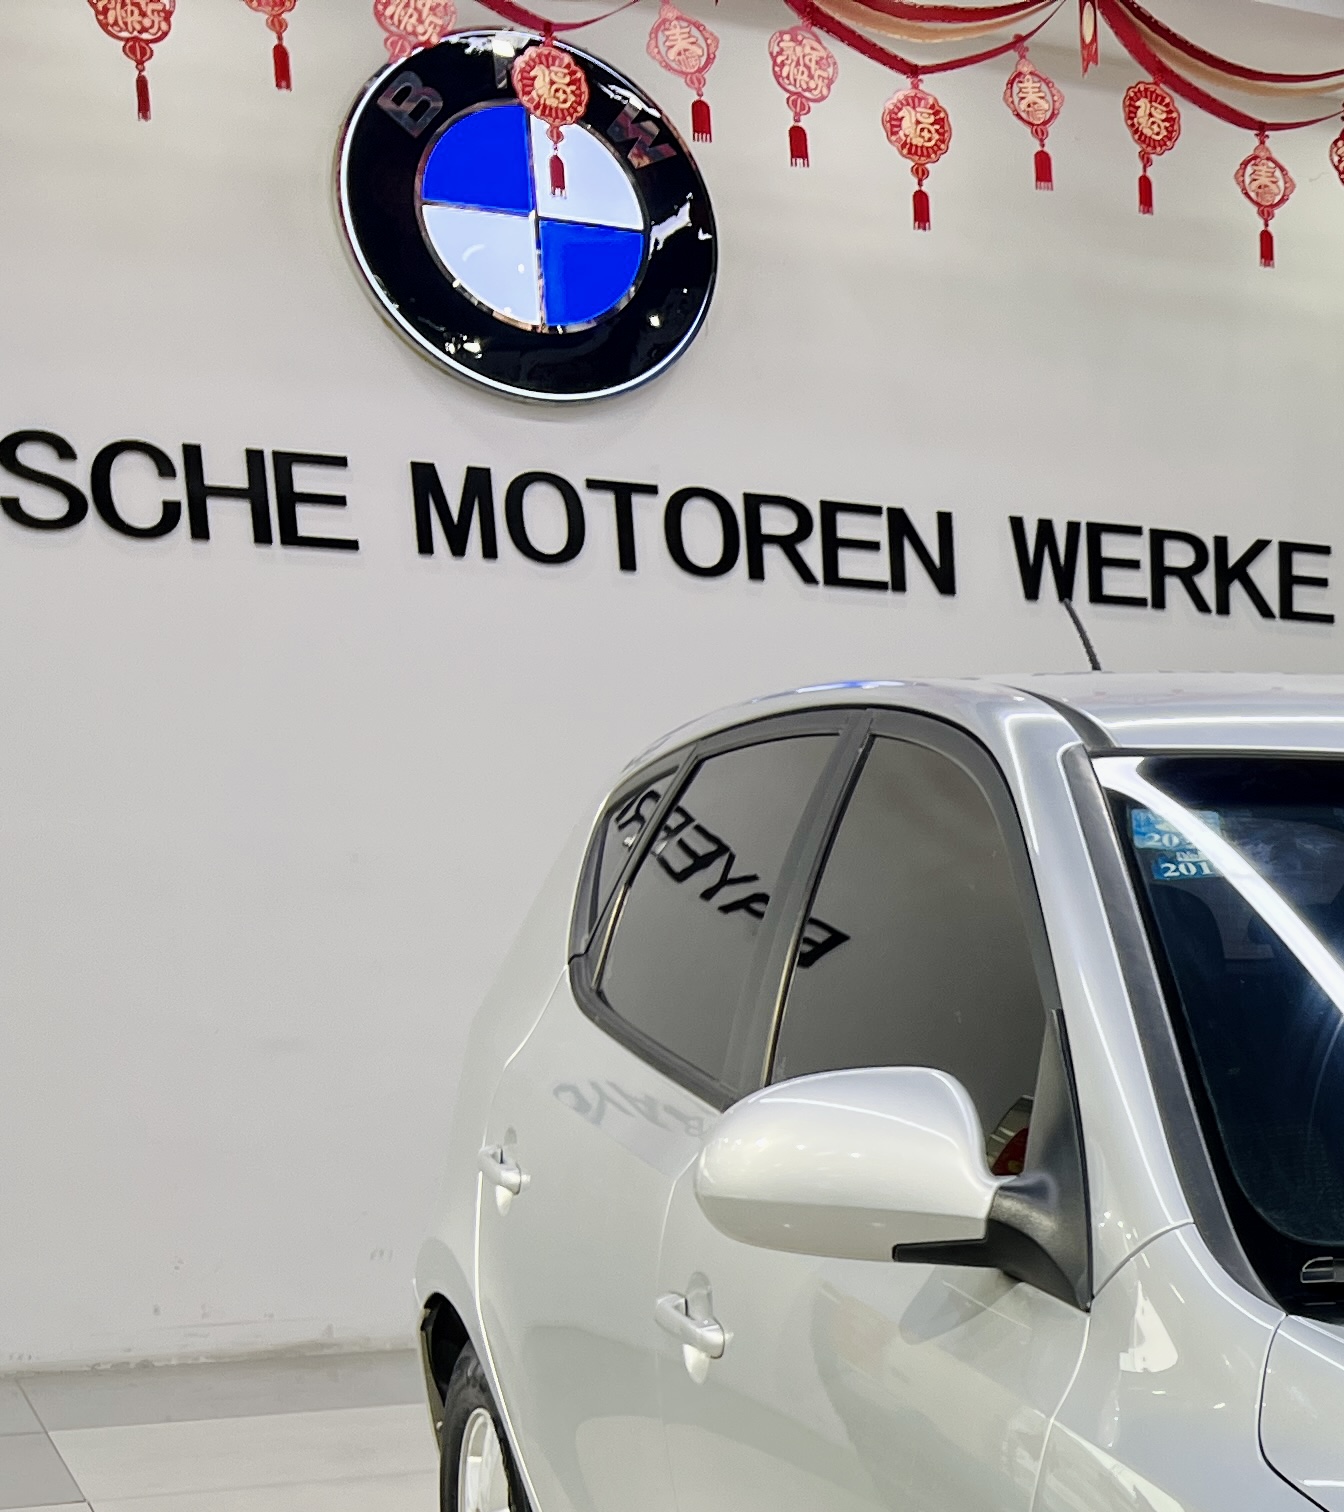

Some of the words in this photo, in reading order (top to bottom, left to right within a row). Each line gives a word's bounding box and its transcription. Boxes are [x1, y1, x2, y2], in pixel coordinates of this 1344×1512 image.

[377, 40, 678, 169] BW
[0, 430, 359, 552] SCHE
[409, 460, 957, 597] MOTOREN
[1008, 515, 1336, 625] WERKE
